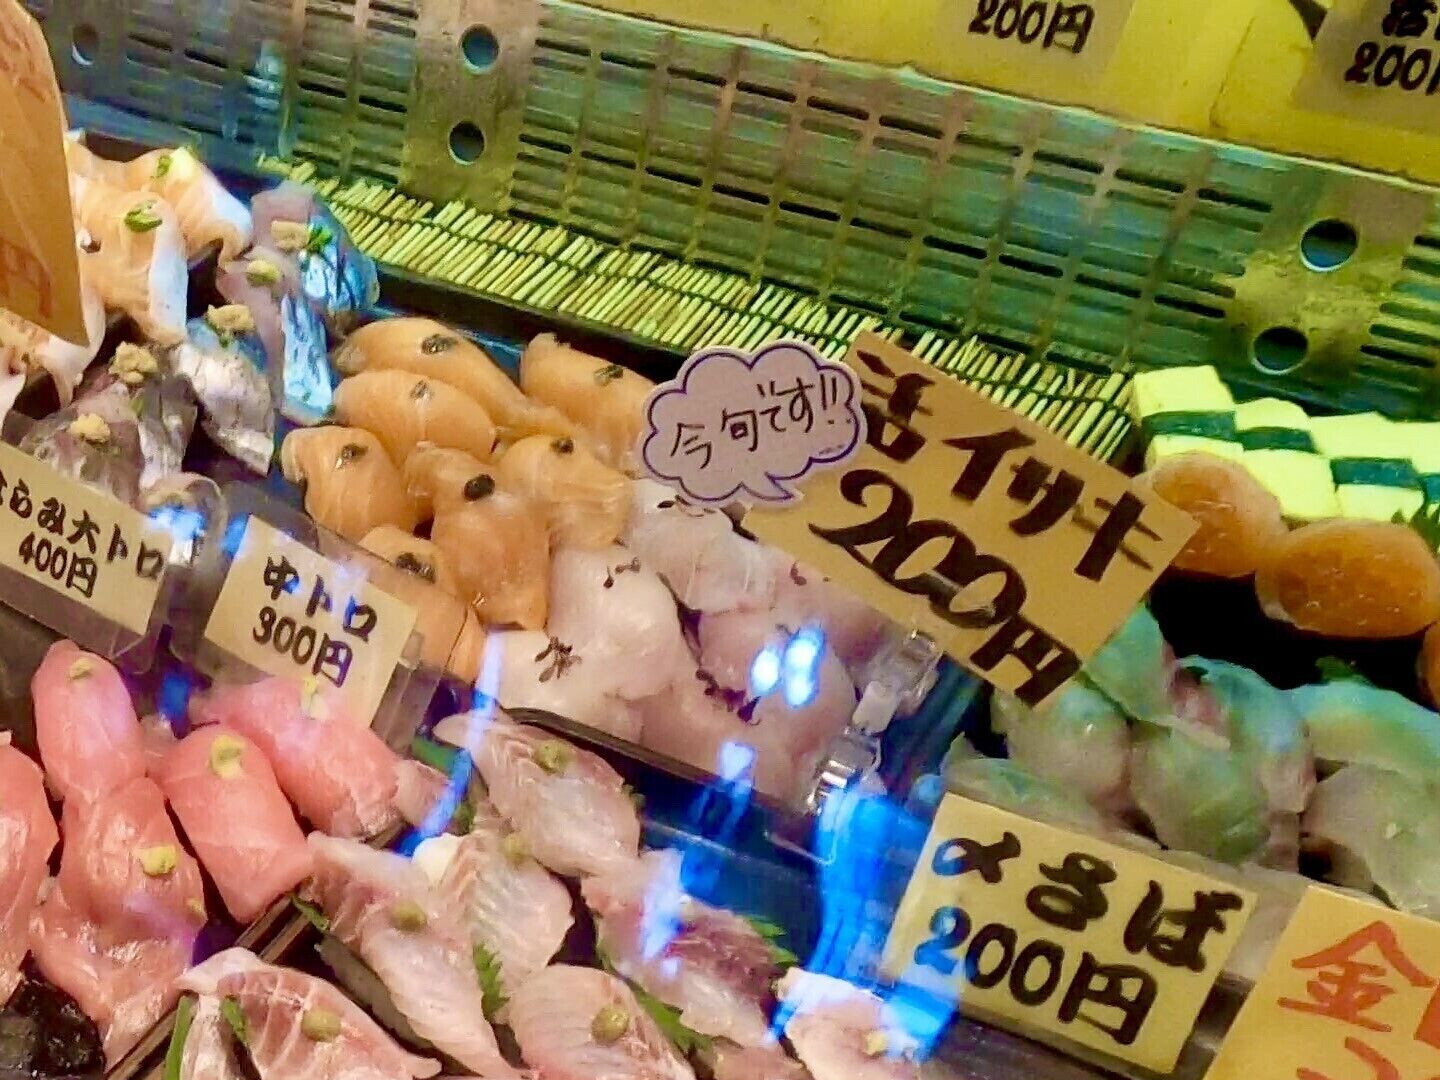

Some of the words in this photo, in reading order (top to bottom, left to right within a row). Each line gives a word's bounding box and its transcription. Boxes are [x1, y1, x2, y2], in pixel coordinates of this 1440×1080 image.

[967, 0, 1095, 54] 200円
[1344, 42, 1440, 96] 200
[19, 532, 98, 598] 400円
[263, 556, 378, 643] 中トロ
[808, 469, 1082, 708] 200円
[252, 606, 354, 688] 300円
[914, 906, 1158, 1045] 200円
[1278, 920, 1440, 1050] 金
